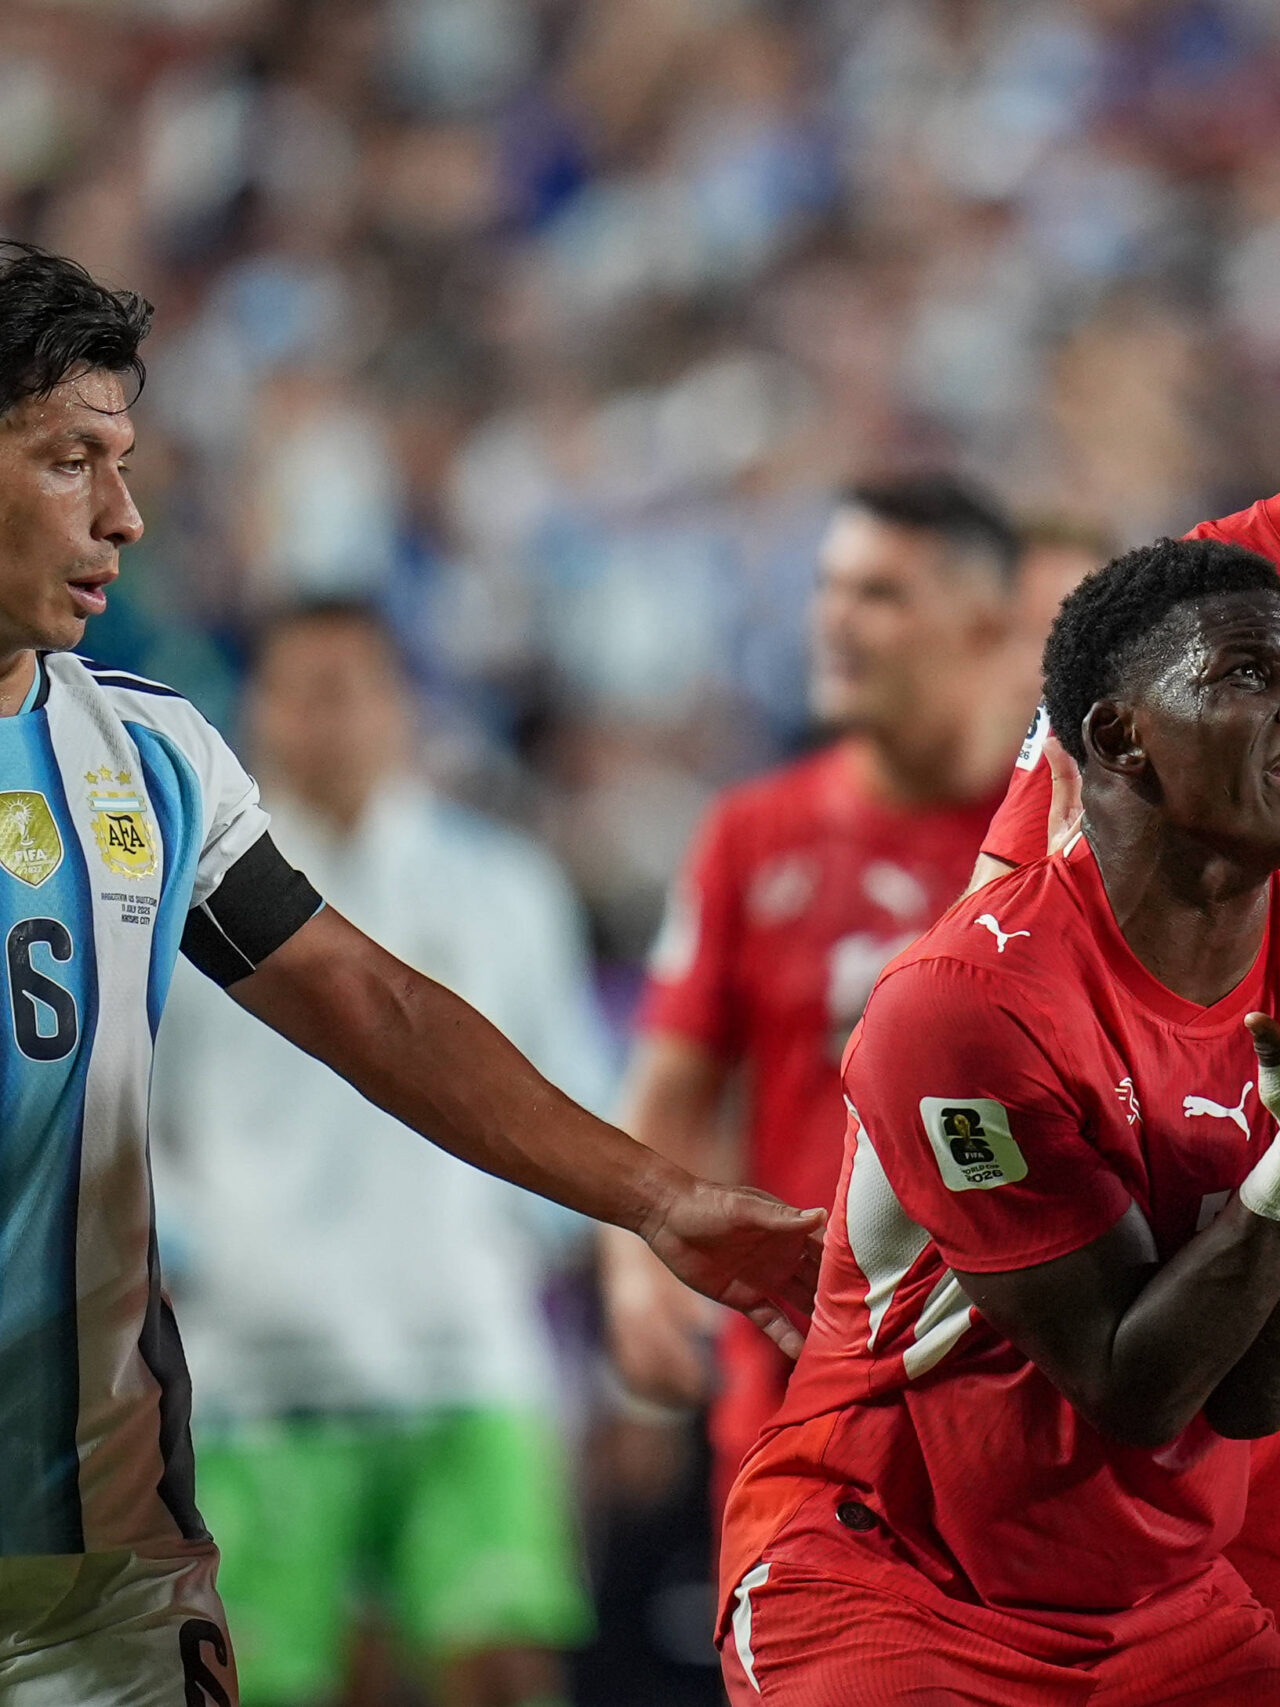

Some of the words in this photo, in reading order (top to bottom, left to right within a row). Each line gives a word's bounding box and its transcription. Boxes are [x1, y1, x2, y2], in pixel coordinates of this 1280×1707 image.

[105, 813, 145, 855] AFA
[15, 848, 47, 863] FIFA
[140, 916, 150, 925] CITY
[6, 917, 80, 1063] 6
[964, 1152, 984, 1160] FIFA
